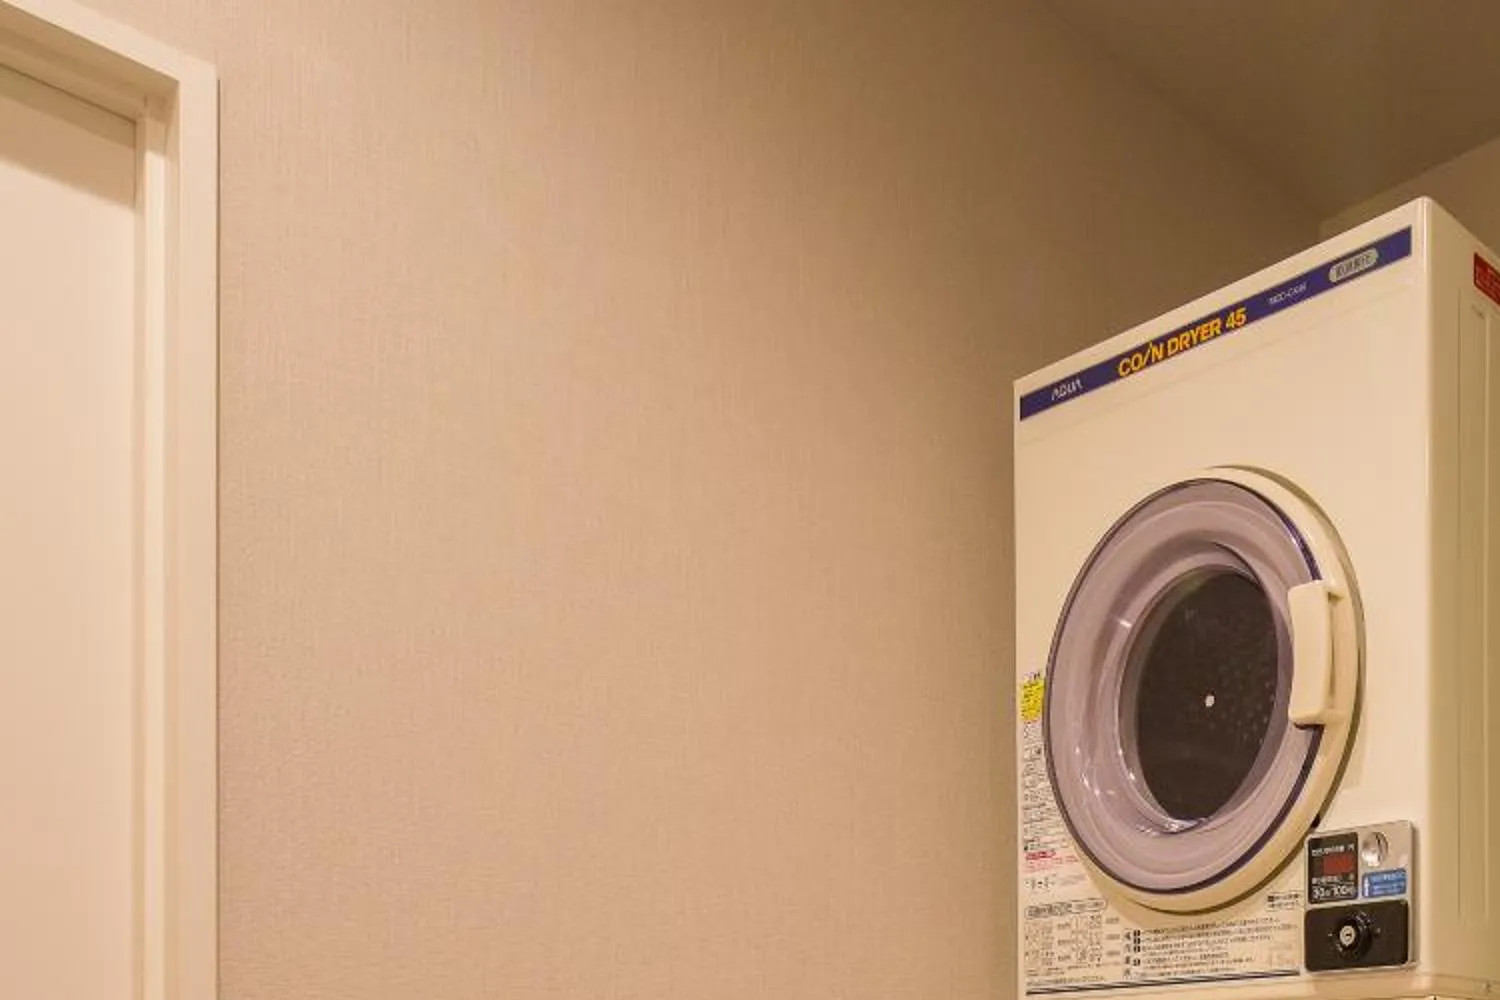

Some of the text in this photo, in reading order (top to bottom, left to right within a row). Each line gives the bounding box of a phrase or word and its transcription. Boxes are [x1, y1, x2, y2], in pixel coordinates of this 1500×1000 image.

[1117, 307, 1247, 377] COIN DRYER 45
